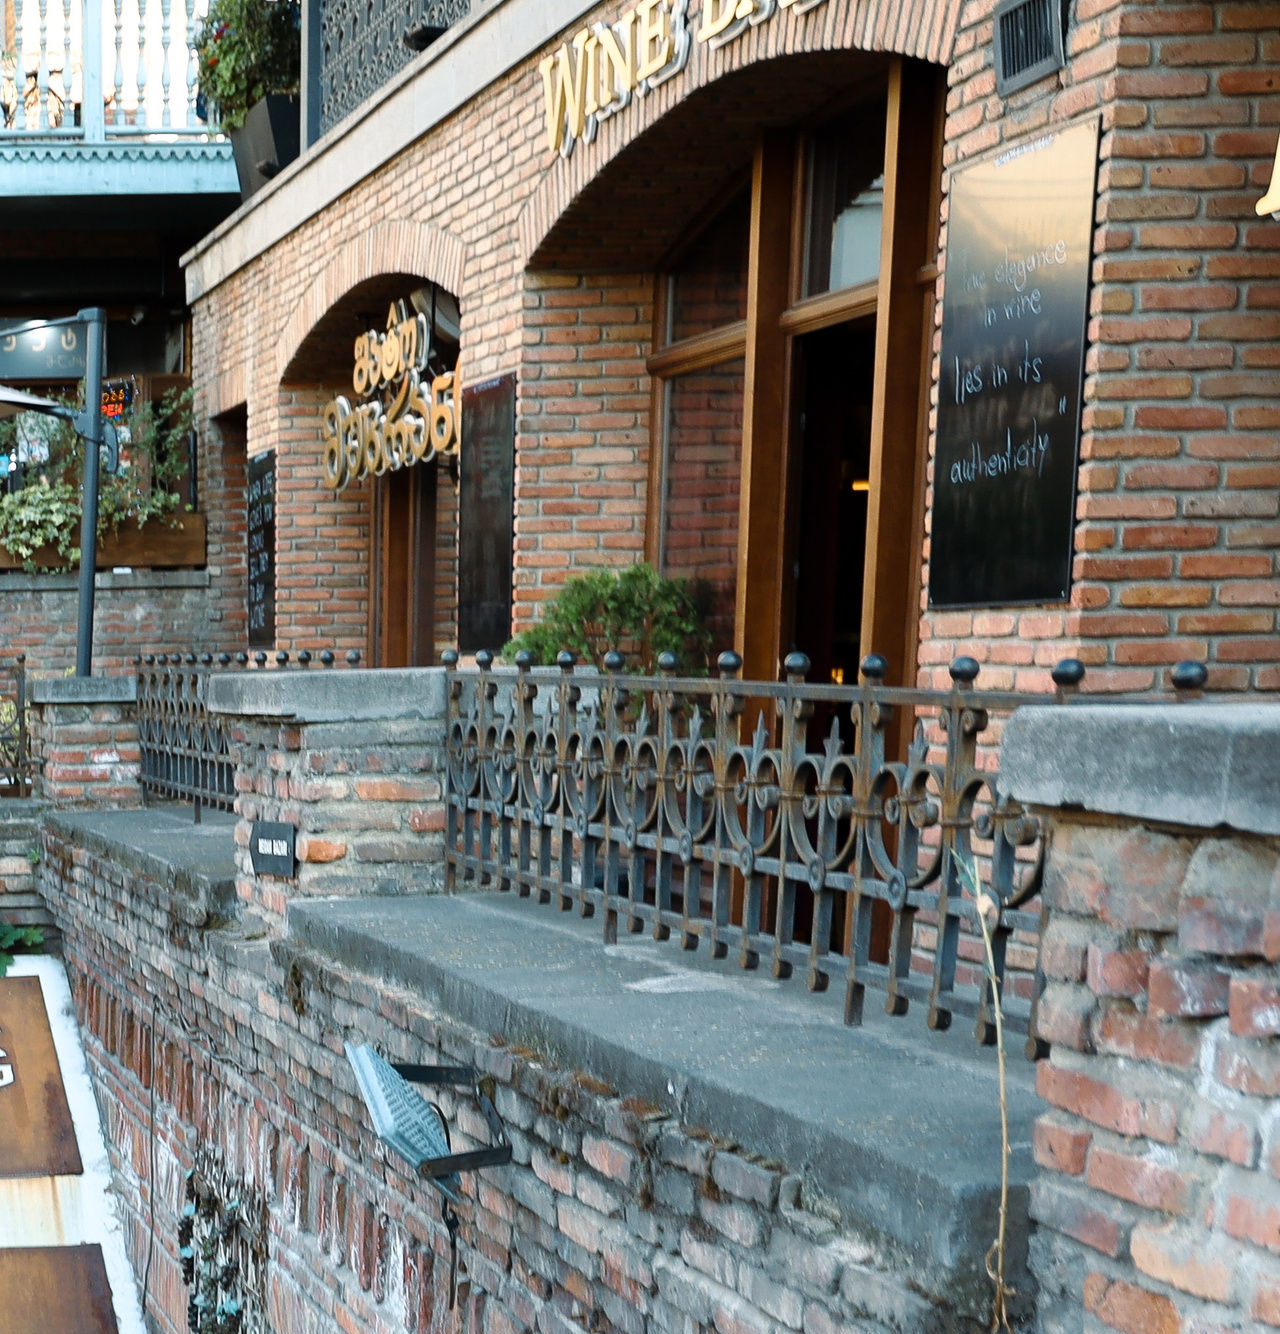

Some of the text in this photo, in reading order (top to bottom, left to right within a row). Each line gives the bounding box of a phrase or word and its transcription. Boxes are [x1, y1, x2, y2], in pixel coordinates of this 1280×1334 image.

[539, 0, 669, 151] WINE
[995, 240, 1067, 292] elegance
[1004, 288, 1042, 319] wine
[955, 339, 1043, 405] lies in its
